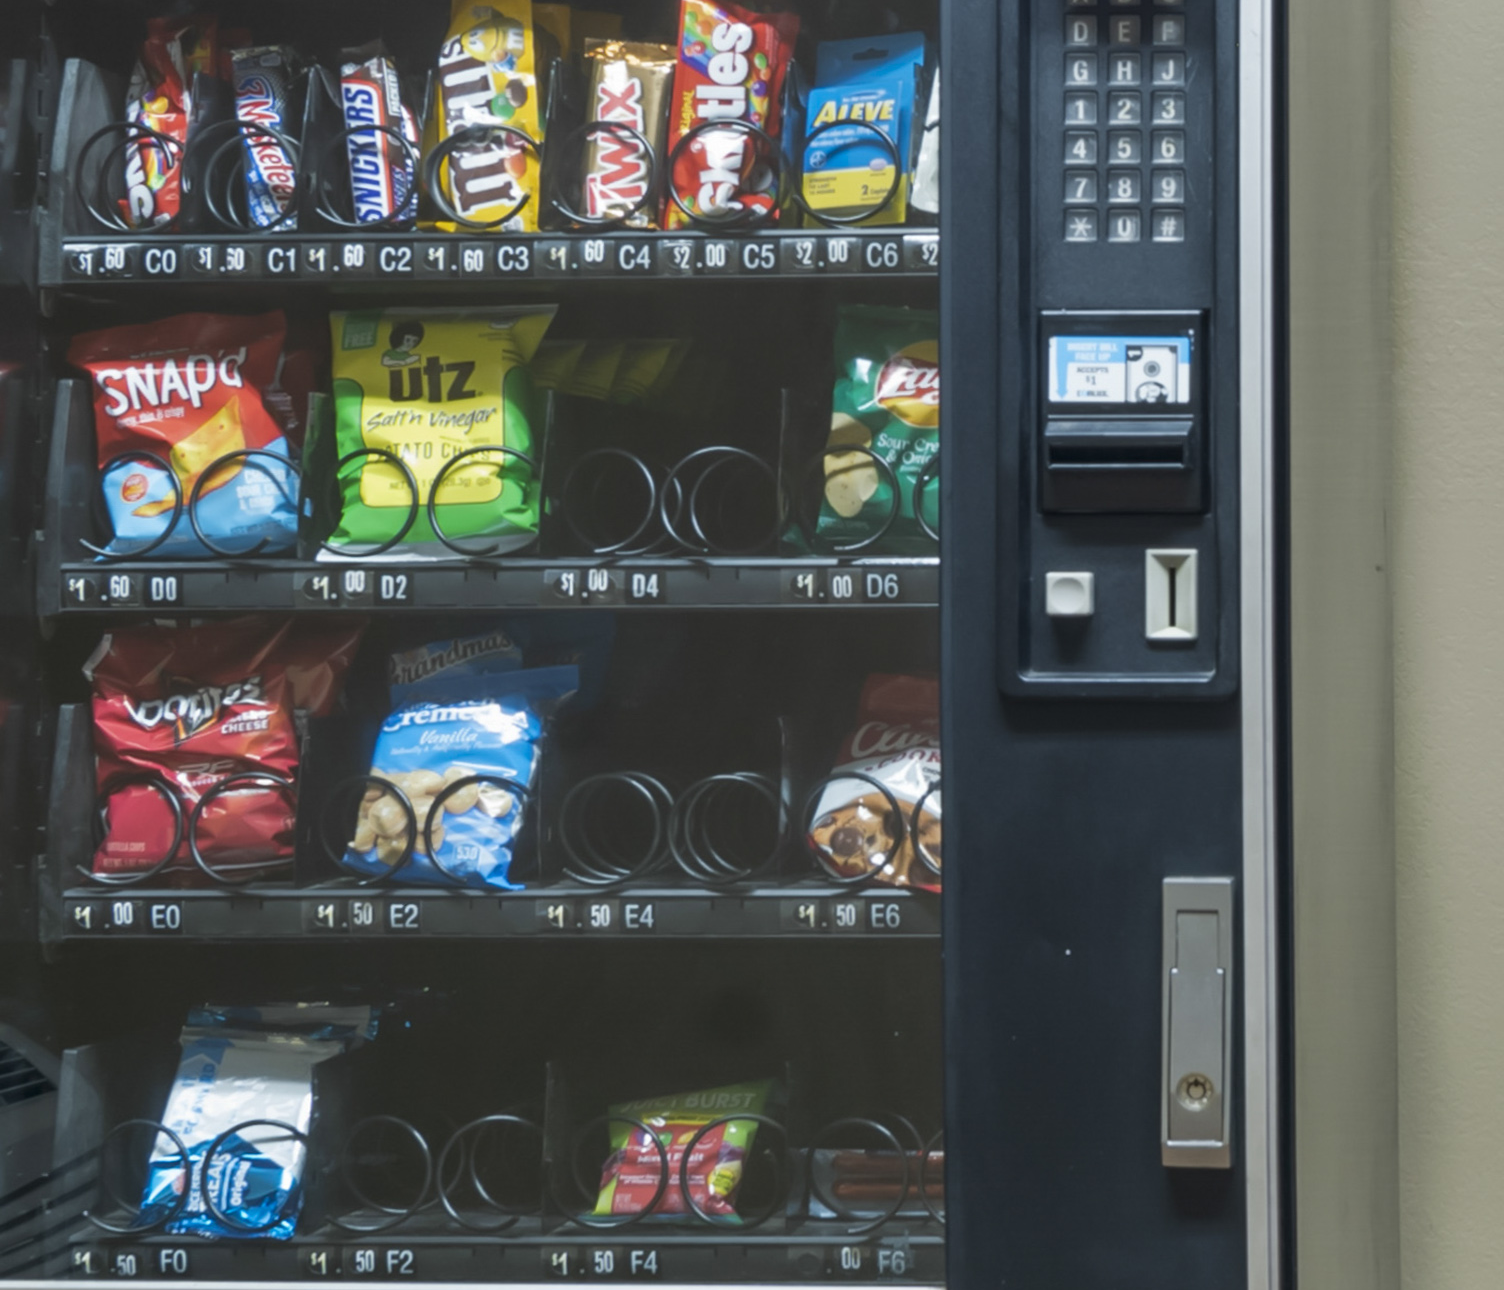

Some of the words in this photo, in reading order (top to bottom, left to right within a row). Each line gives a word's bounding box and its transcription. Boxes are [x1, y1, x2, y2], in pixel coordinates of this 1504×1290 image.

[1074, 21, 1088, 43] D
[1119, 21, 1131, 43] E
[1073, 60, 1088, 81] G
[1117, 60, 1132, 81] H
[1161, 59, 1175, 81] J
[236, 76, 272, 100] 3
[696, 22, 754, 218] Skitles
[1076, 100, 1086, 120] 1
[1117, 99, 1132, 120] 2
[1161, 99, 1176, 120] 3
[343, 86, 384, 225] SNICKERS
[586, 77, 644, 219] TWIX
[1072, 138, 1087, 159] 4
[1117, 137, 1132, 159] 5
[1161, 137, 1176, 159] 6
[1075, 177, 1088, 198] 7
[1117, 177, 1132, 199] 8
[1161, 177, 1176, 199] 9
[1117, 217, 1132, 238] 0
[145, 249, 176, 273] C0
[268, 249, 296, 272] C1
[380, 248, 412, 272] C2
[498, 246, 530, 271] C3
[619, 244, 651, 270] C4
[743, 243, 775, 269] C5
[866, 242, 898, 268] C6
[345, 332, 374, 347] FREE
[428, 407, 497, 435] Vinegar
[877, 433, 910, 450] Sour
[151, 576, 177, 600] D0
[381, 575, 407, 599] D2
[632, 573, 659, 597] D4
[867, 573, 898, 598] D6
[221, 719, 269, 735] CHEESE
[420, 727, 478, 746] Vanilla
[151, 904, 180, 929] E0
[390, 903, 418, 928] E2
[625, 904, 654, 928] E4
[871, 903, 900, 928] E6
[685, 1093, 756, 1110] BURST
[230, 1160, 251, 1206] Original
[160, 1249, 188, 1274] F0
[386, 1249, 414, 1274] F2
[630, 1250, 659, 1274] F4
[877, 1250, 906, 1274] F6
